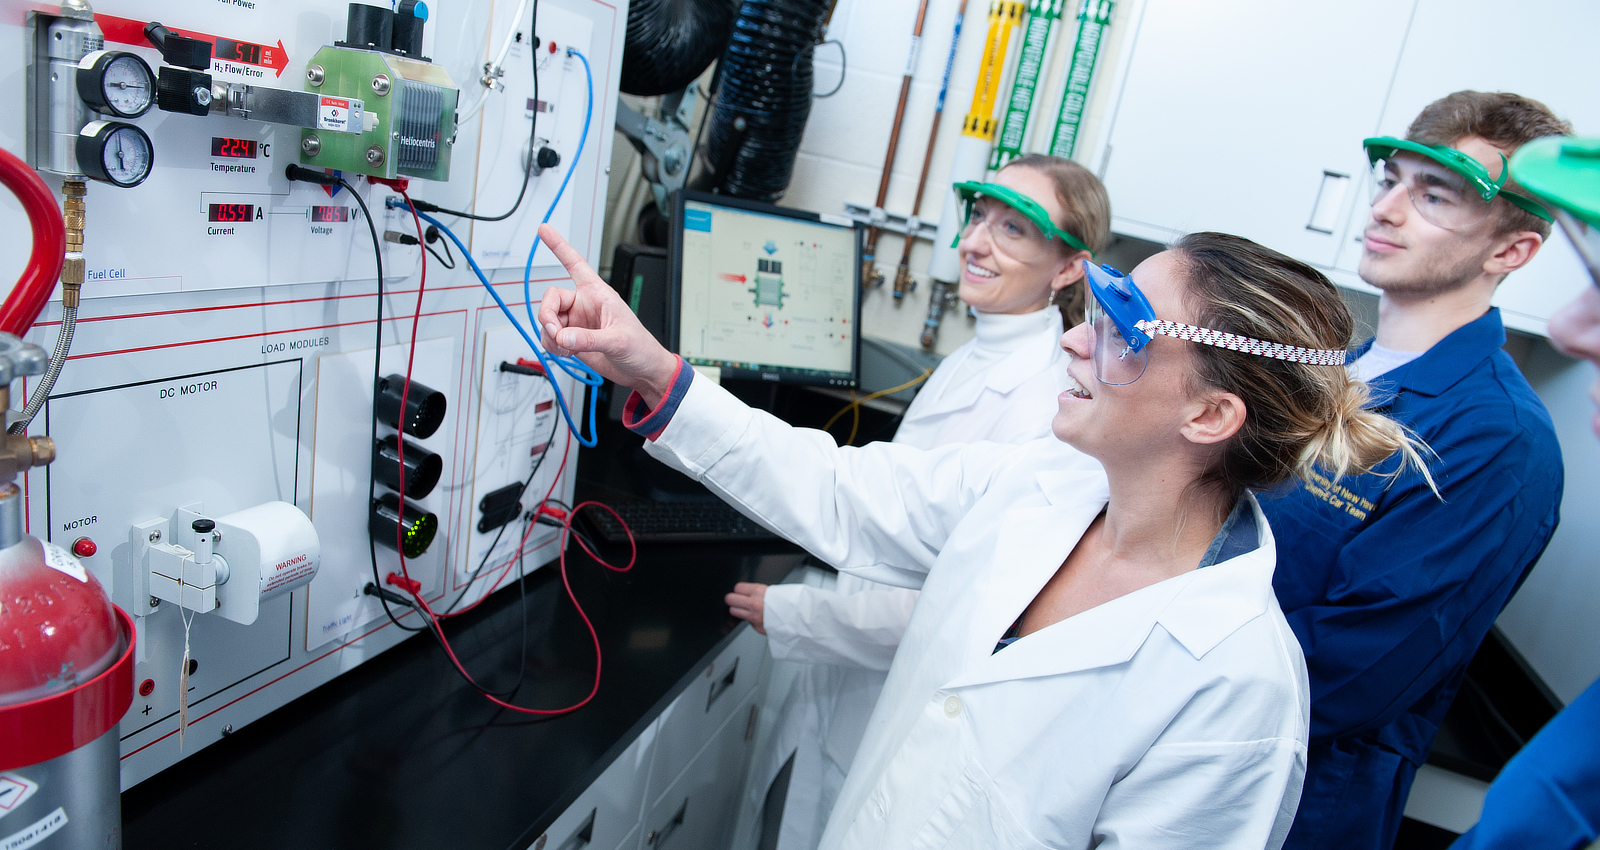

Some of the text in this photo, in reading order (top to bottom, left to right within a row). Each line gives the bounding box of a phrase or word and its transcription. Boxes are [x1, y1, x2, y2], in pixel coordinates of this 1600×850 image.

[1068, 20, 1101, 93] NONPOTABLE
[224, 63, 263, 78] Flow/Error
[1002, 16, 1050, 149] NONPOTABLE HOT WATER
[1061, 92, 1084, 123] COLD
[221, 137, 249, 157] 22.4
[400, 135, 436, 149] Heliocentris
[210, 162, 256, 173] Temperature
[217, 204, 246, 221] 0.59
[255, 206, 264, 220] A
[351, 208, 359, 220] V
[207, 226, 235, 236] Current
[310, 225, 334, 235] Voltage
[88, 268, 126, 280] Fuel Cell
[261, 336, 330, 354] LOAD MODULES
[160, 380, 218, 399] DC MOTOR
[1340, 486, 1361, 505] New
[1328, 494, 1345, 509] Car
[1344, 501, 1367, 522] Team
[63, 515, 98, 532] MOTOR
[275, 553, 307, 571] WARNING
